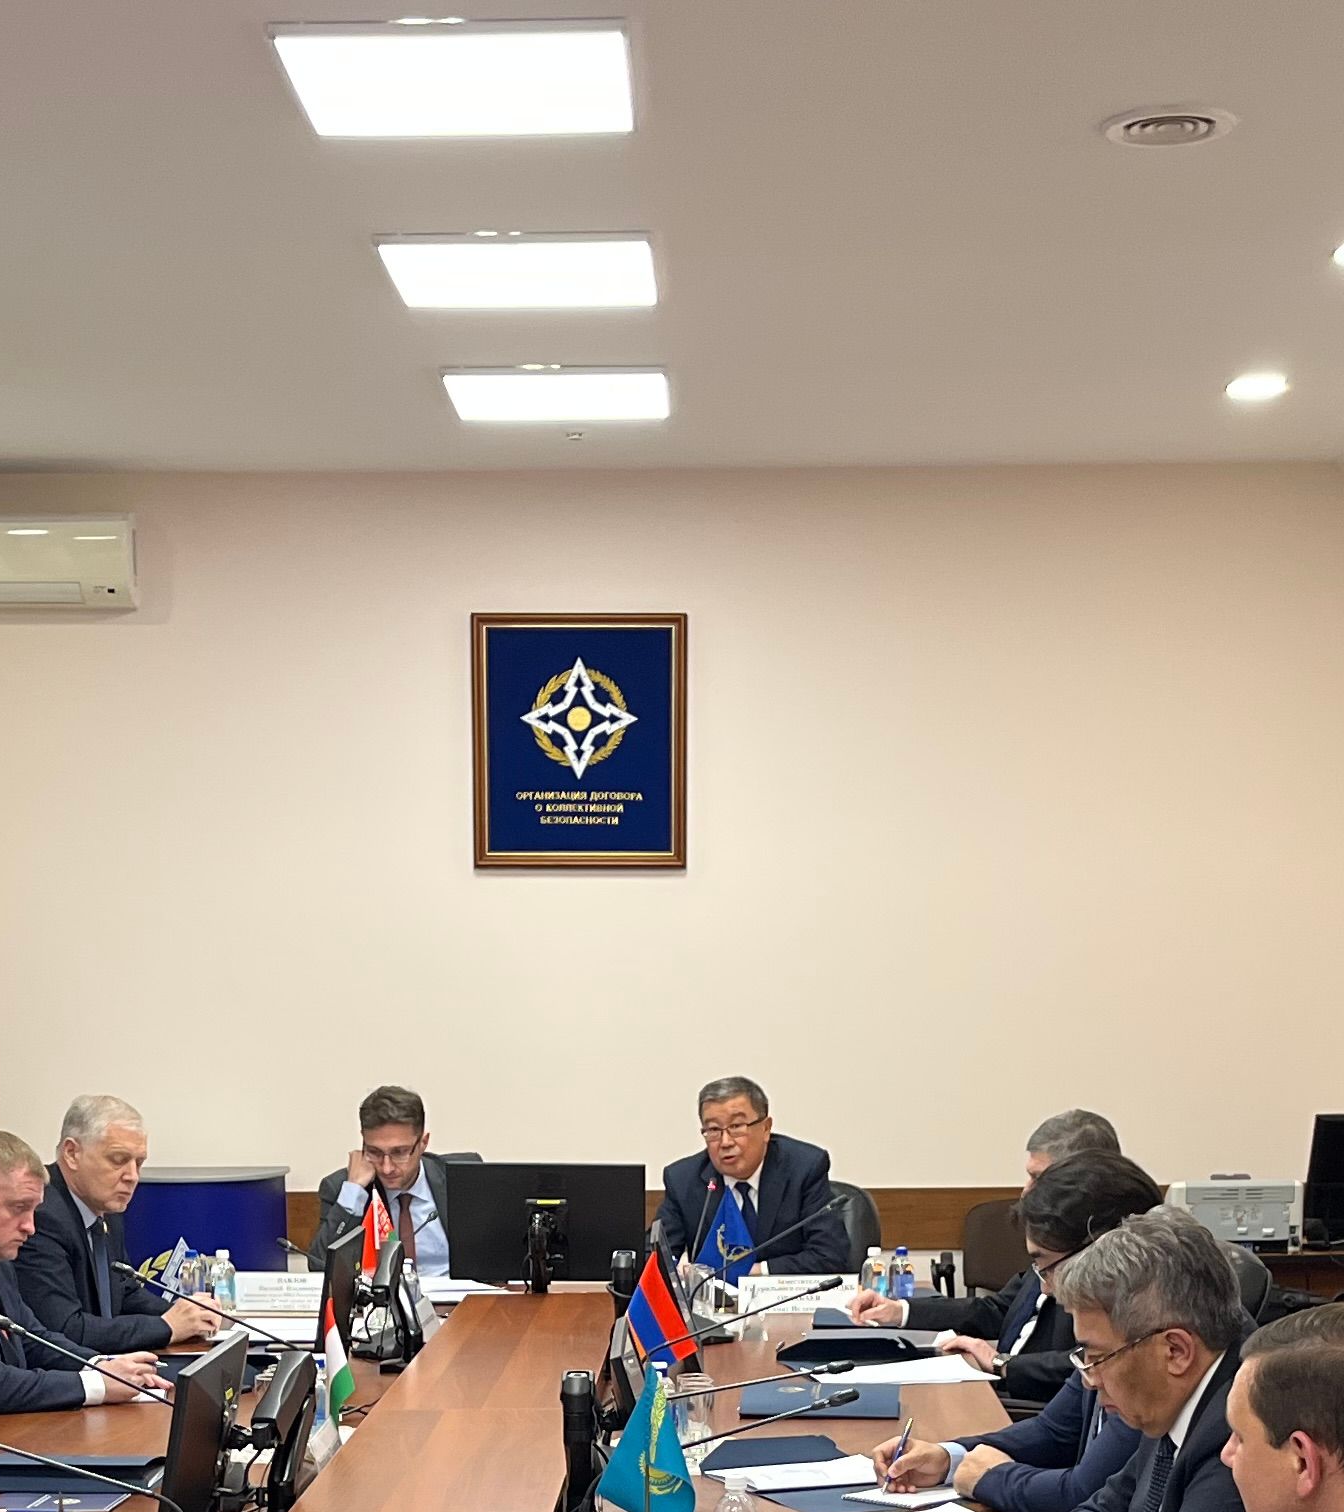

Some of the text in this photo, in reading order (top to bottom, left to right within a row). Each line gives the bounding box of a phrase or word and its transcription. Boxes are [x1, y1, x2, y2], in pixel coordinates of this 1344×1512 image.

[515, 790, 643, 802] ОРГАНИЗАЦИЯ ДОГОВОРА
[534, 802, 624, 813] О КОЛЛЕКТИВНОЙ
[539, 815, 619, 825] БЕЗОПАСНОСТИ
